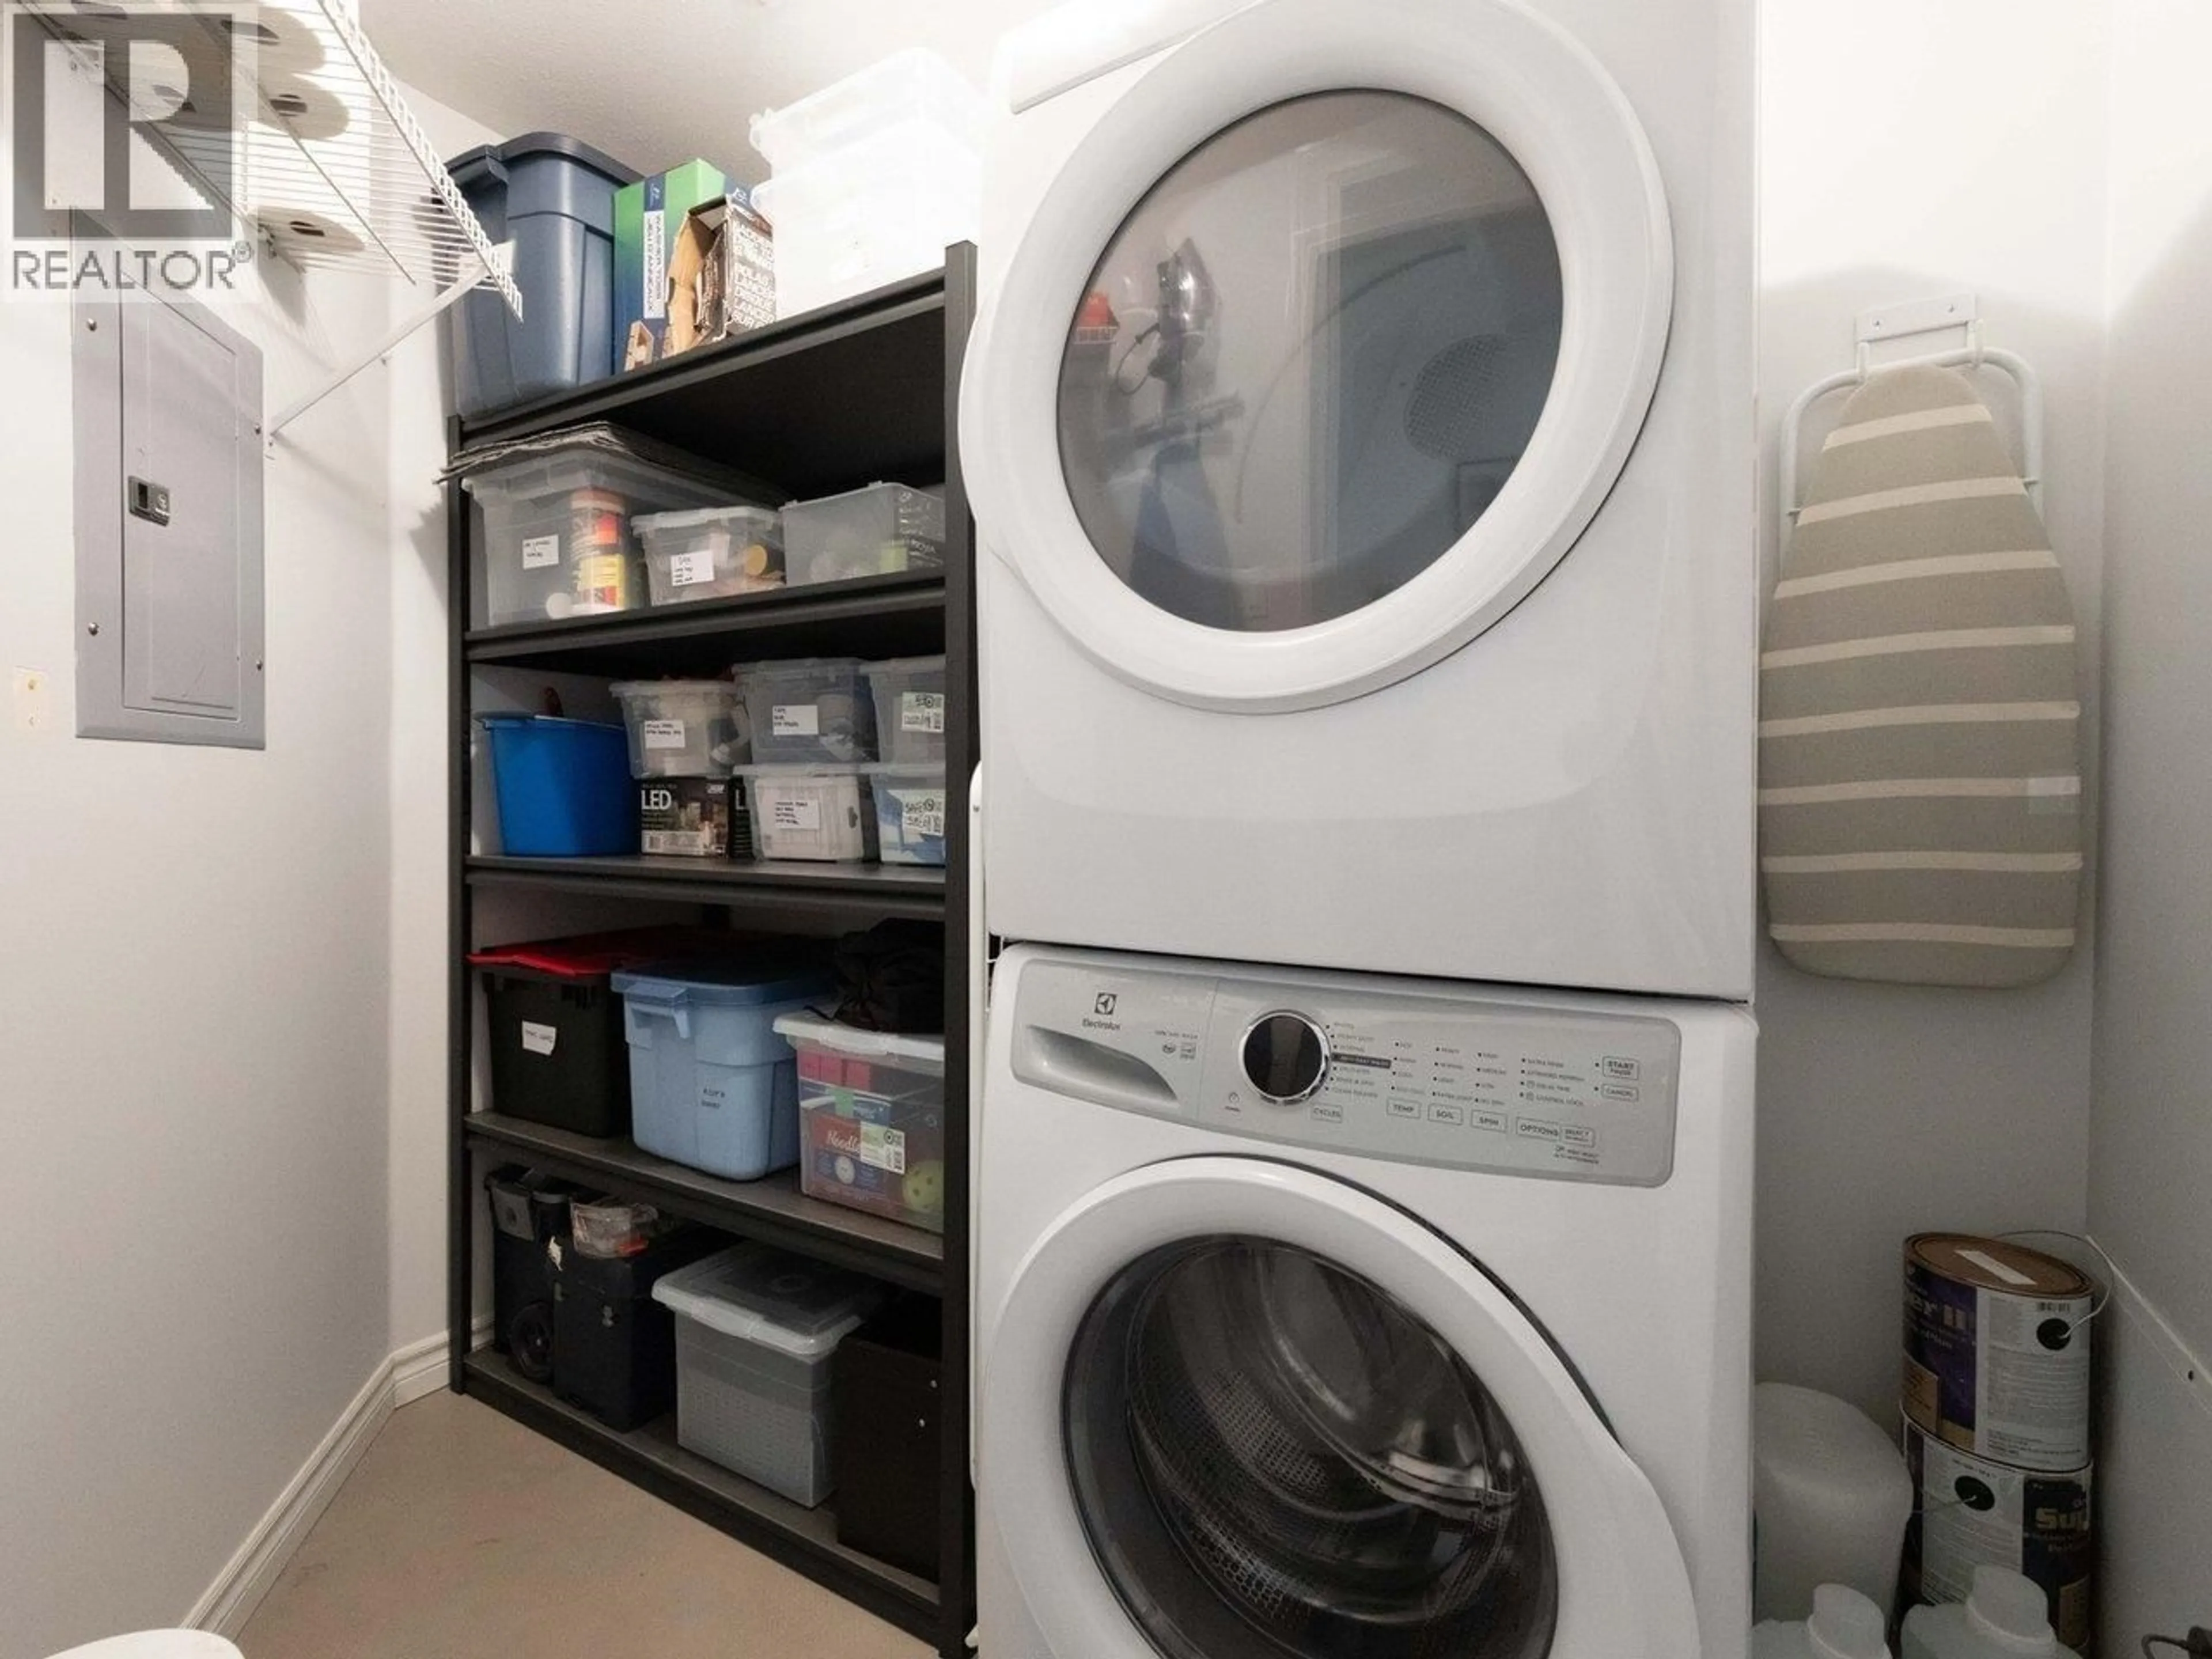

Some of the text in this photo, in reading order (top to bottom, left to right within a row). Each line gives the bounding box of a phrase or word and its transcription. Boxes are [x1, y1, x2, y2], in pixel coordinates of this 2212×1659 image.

[641, 789, 672, 810] LED
[1082, 1018, 1121, 1031] Electrolux
[1393, 1104, 1415, 1113] TEMP
[1436, 1109, 1455, 1120] SOIL
[1479, 1116, 1499, 1126] SPIN
[1520, 1124, 1559, 1137] OPTIONS
